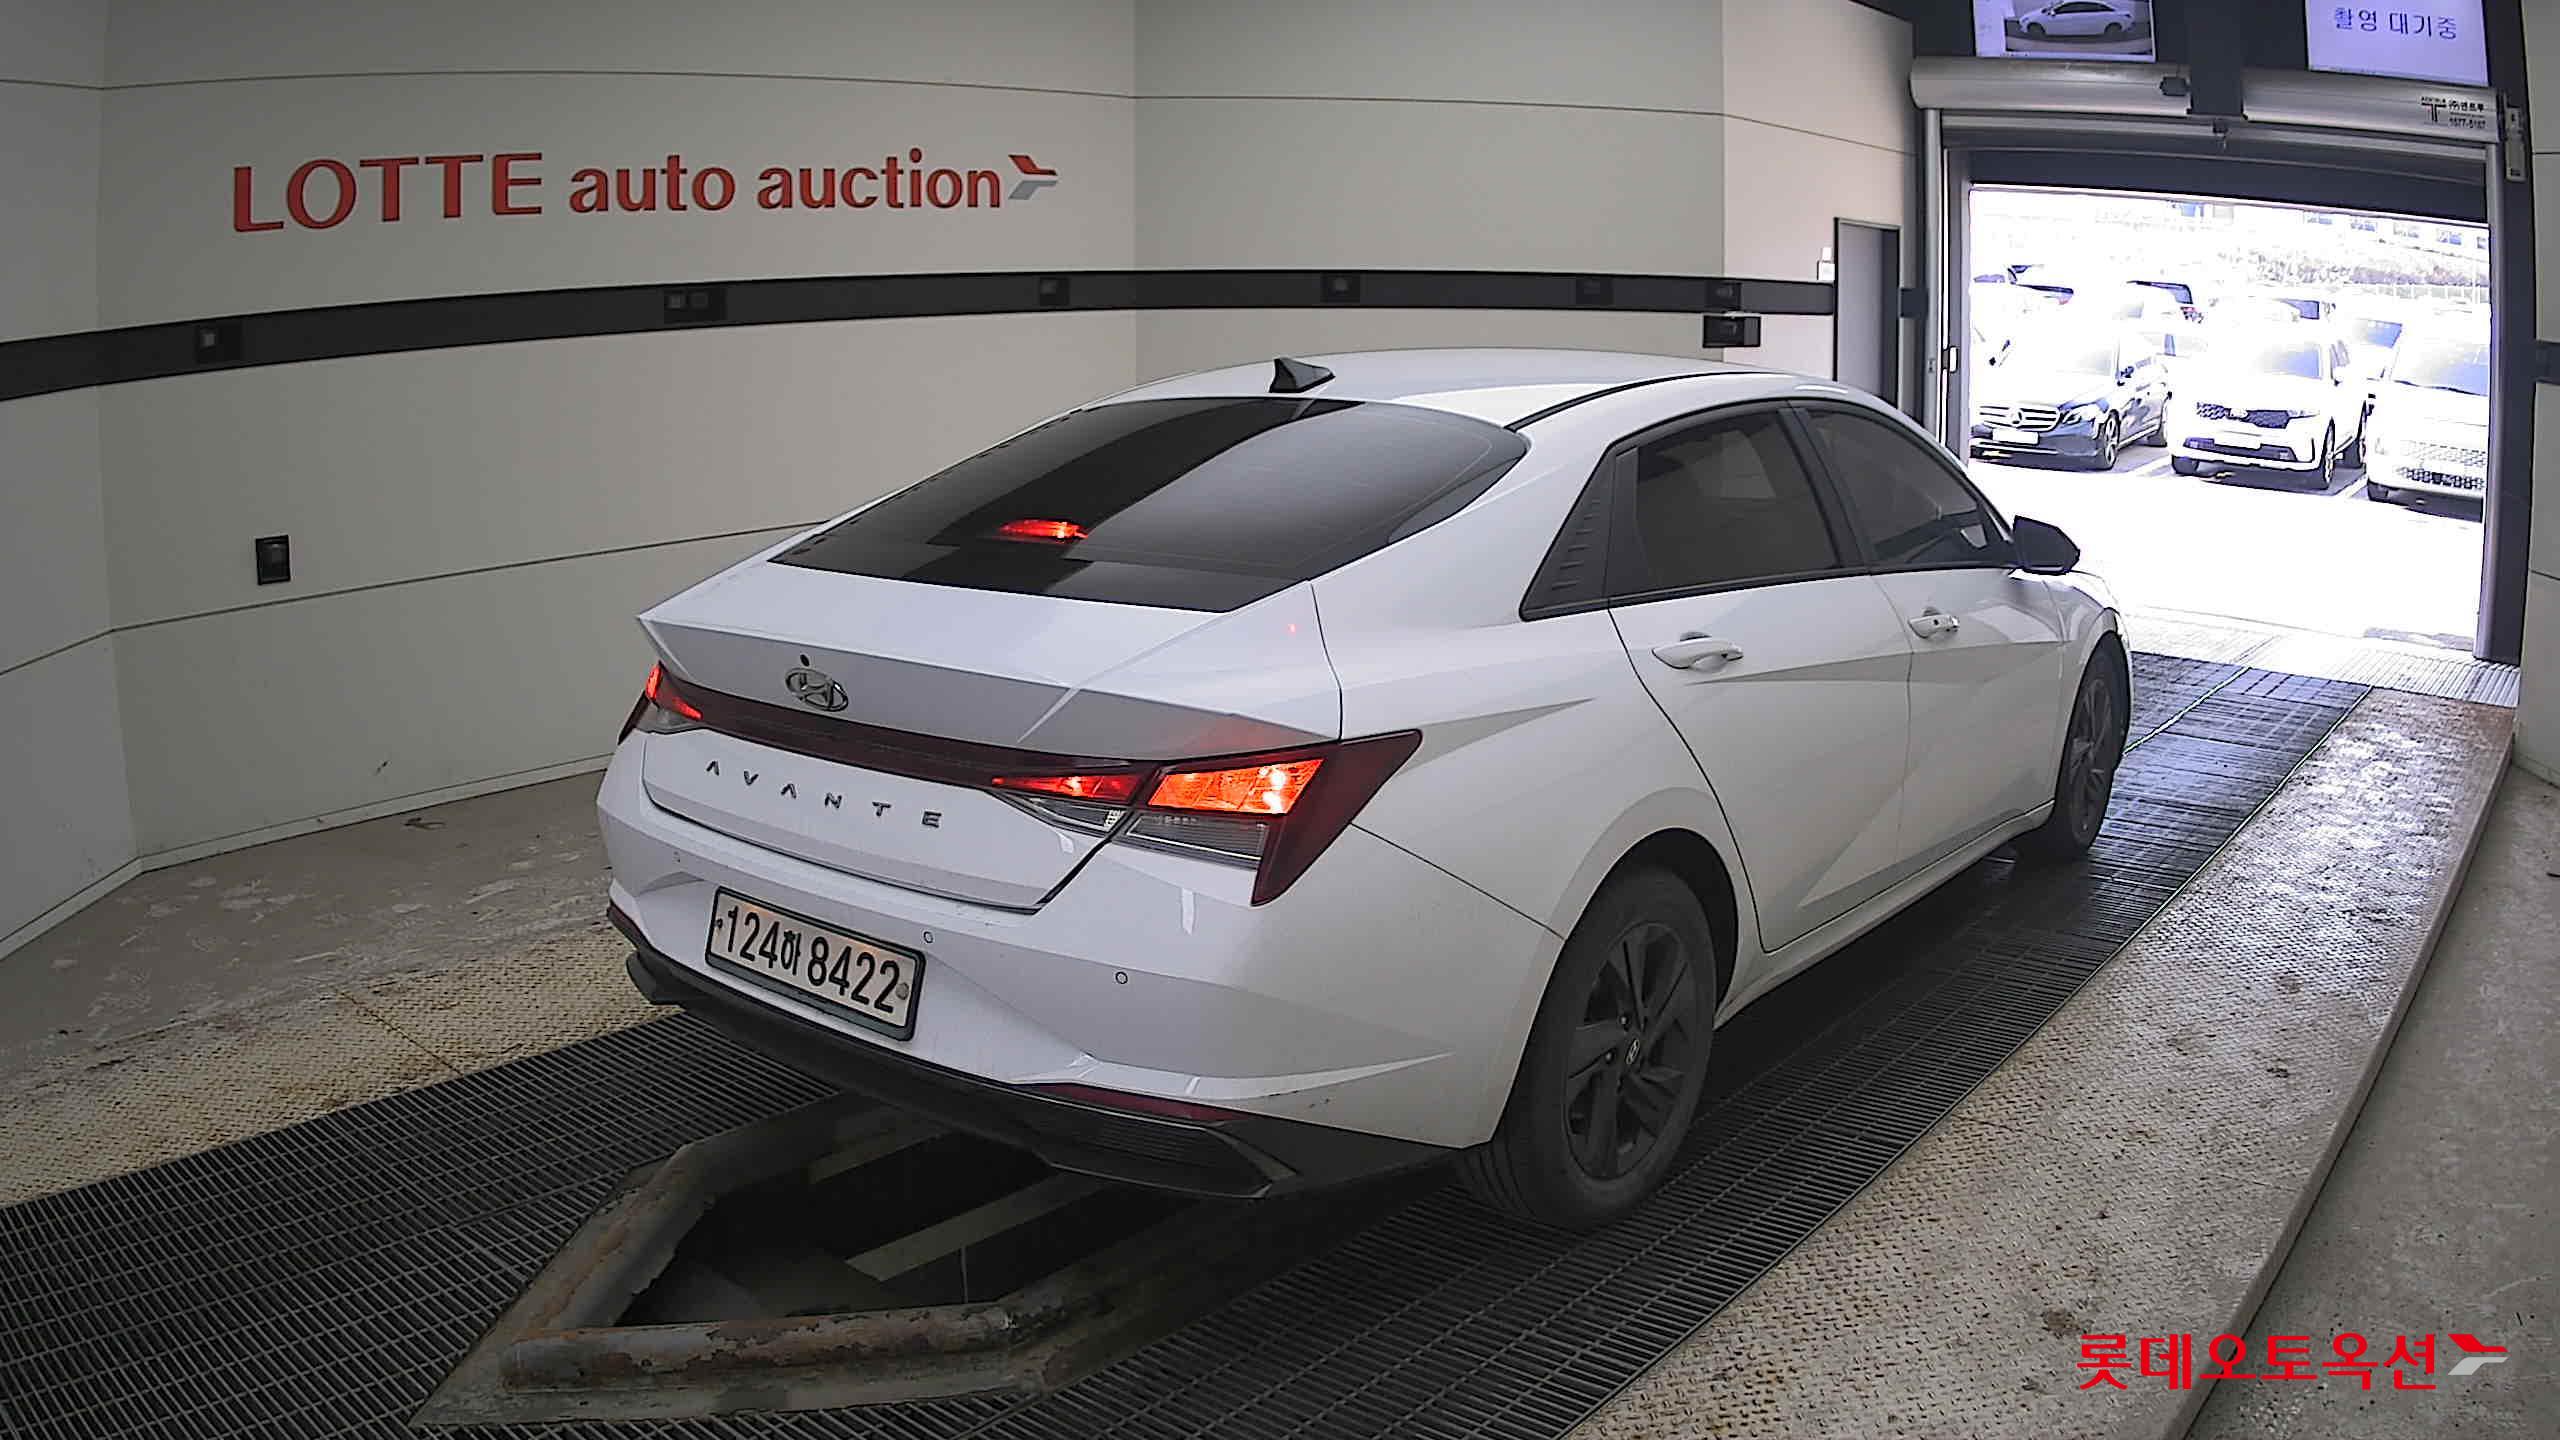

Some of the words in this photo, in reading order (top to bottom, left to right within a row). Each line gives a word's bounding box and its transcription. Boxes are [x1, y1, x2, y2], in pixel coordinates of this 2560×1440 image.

[2335, 7, 2377, 32] 촬영
[2389, 12, 2457, 40] 대기중
[235, 153, 543, 233] LOTTE
[568, 154, 736, 213] auto
[757, 147, 1001, 210] auction
[706, 759, 943, 829] AVANTE
